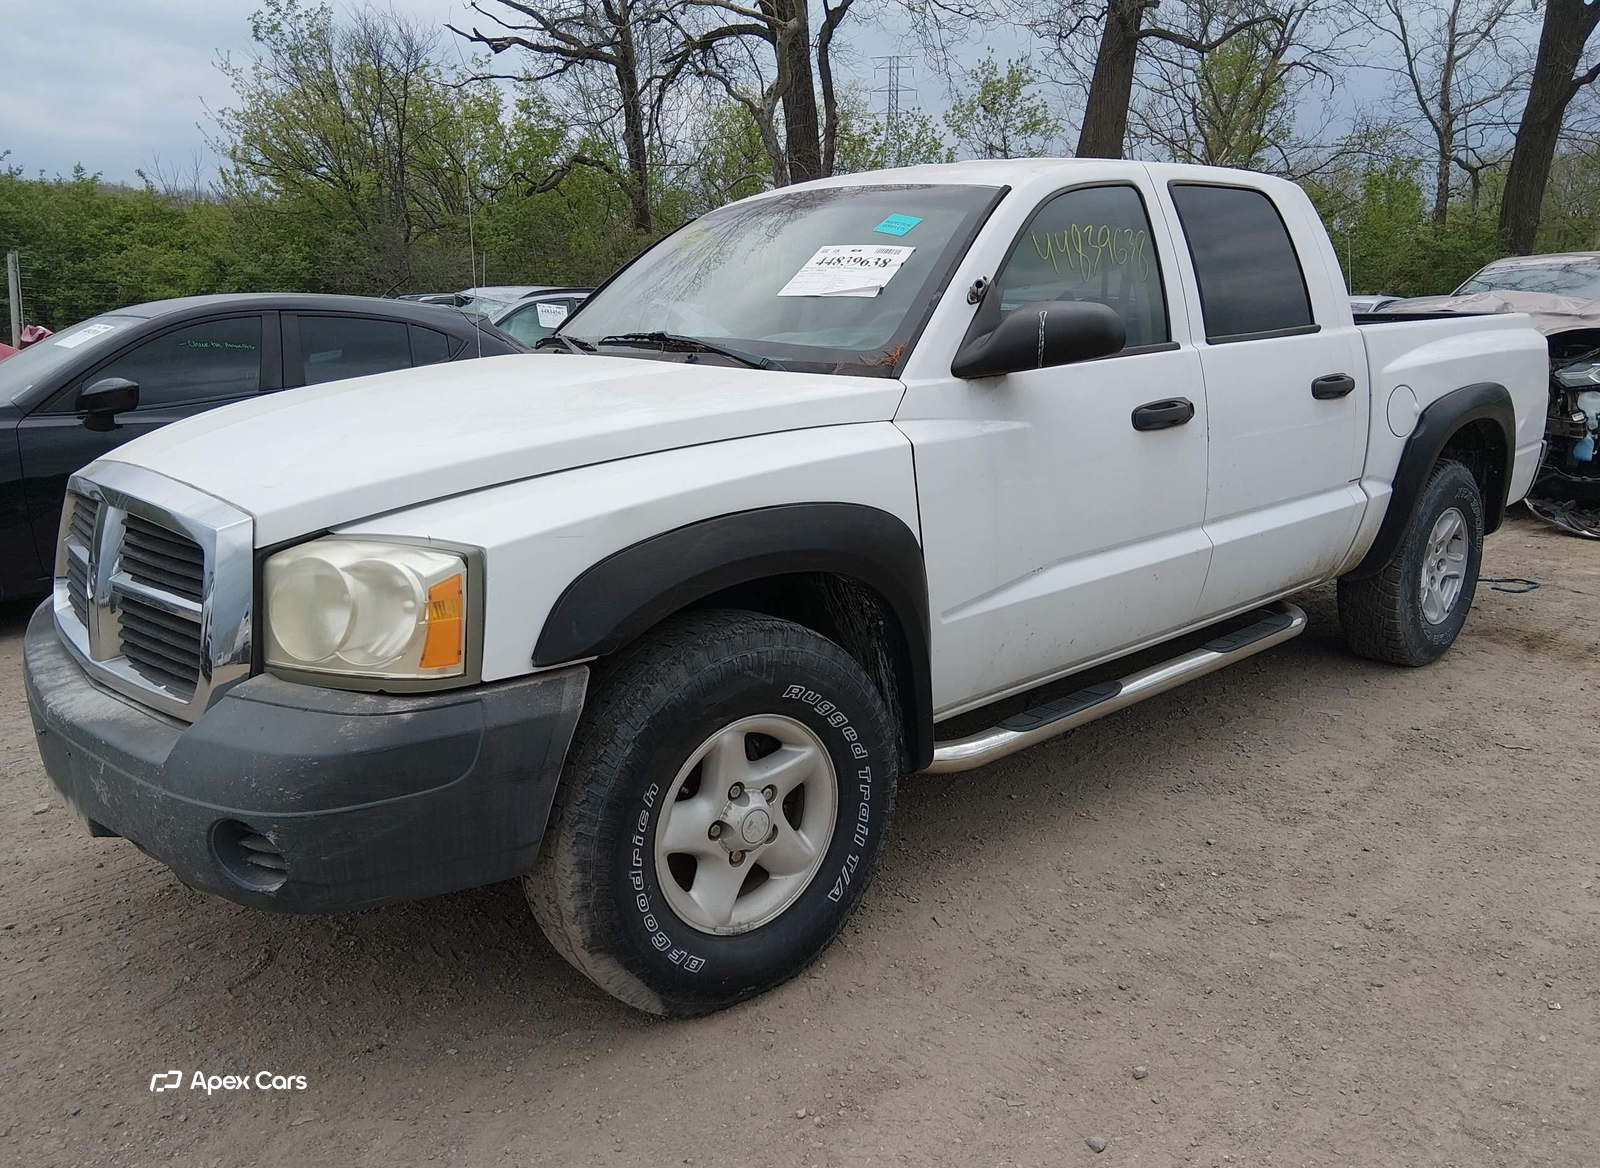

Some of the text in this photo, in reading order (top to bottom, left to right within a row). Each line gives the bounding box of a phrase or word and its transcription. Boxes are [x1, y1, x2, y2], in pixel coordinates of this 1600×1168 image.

[816, 256, 892, 268] 44839638
[1031, 223, 1149, 282] 44839638
[782, 684, 872, 902] Rugged Trail T/A
[628, 783, 706, 973] BFGoodrich
